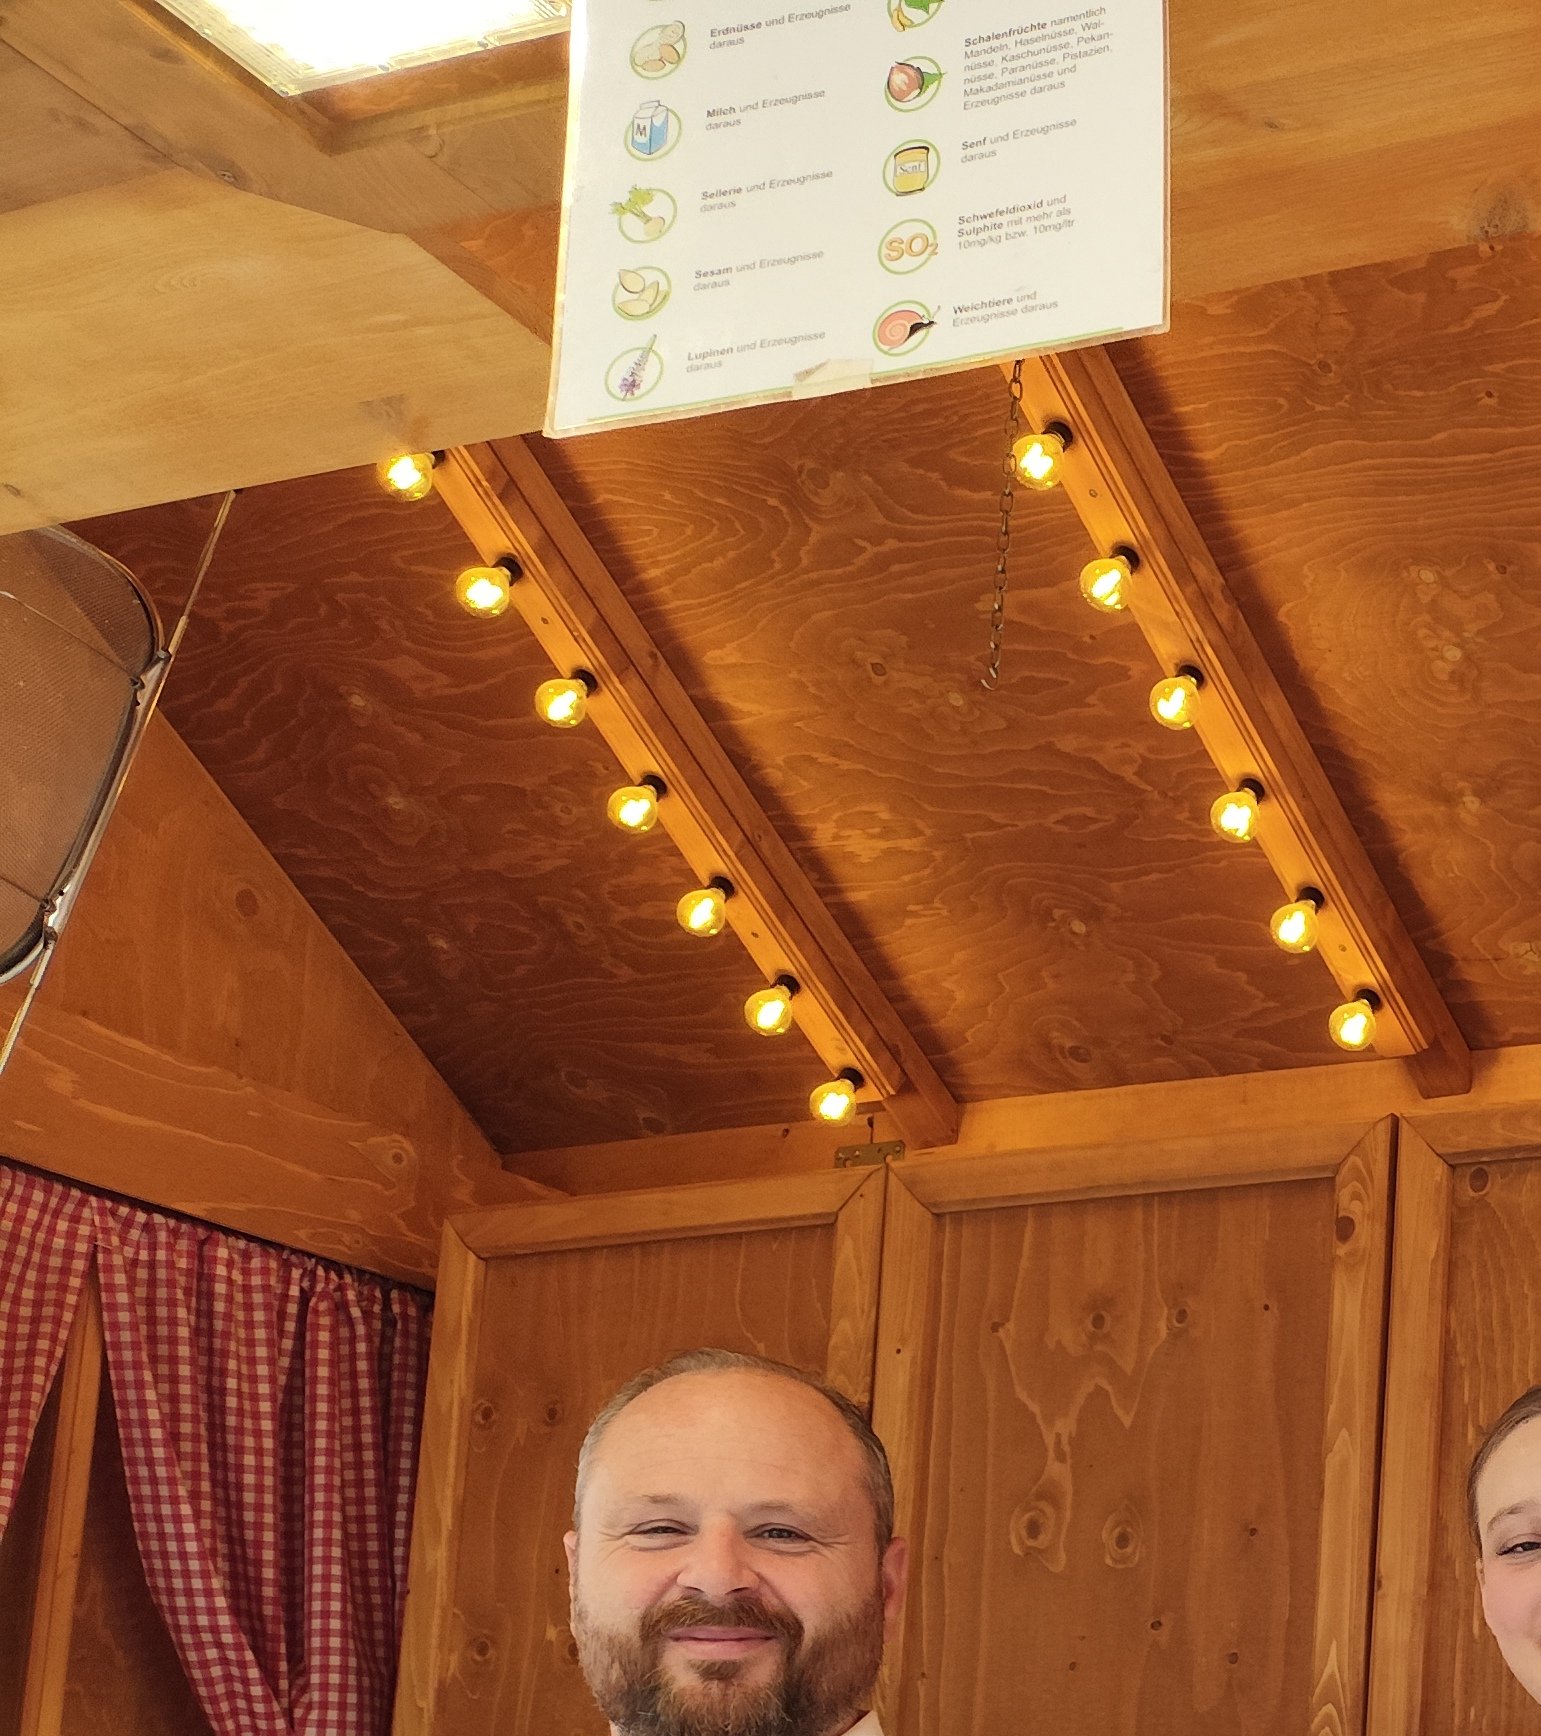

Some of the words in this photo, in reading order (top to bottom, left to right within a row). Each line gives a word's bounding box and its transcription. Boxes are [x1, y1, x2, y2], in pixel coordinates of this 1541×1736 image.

[710, 20, 762, 37] Erdnüsse
[765, 15, 785, 26] und
[788, 3, 851, 23] Erzeugnisse
[964, 20, 1047, 47] Schalenfrüchte
[1050, 5, 1106, 27] namentlich
[709, 36, 745, 49] daraus
[964, 43, 1010, 60] Mandeln,
[1015, 27, 1077, 48] Haselnüsse,
[1081, 19, 1105, 32] Wal-
[1001, 41, 1073, 63] Kaschunüsse,
[1077, 32, 1114, 46] Pekan-
[963, 87, 1027, 111] Erzeugnisse
[1030, 80, 1066, 96] daraus
[964, 68, 1054, 98] Makadamianüsse
[1057, 64, 1078, 78] und
[706, 106, 737, 118] Milch
[739, 101, 759, 113] und
[762, 90, 826, 108] Erzeugnisse
[705, 118, 742, 132] daraus
[961, 136, 987, 151] Senf
[990, 131, 1010, 145] und
[1012, 118, 1077, 140] Erzeugnisse
[960, 149, 997, 164] daraus
[701, 186, 743, 200] Sellerie
[746, 181, 766, 193] und
[769, 170, 833, 190] Erzeugnisse
[700, 200, 736, 213] daraus
[958, 199, 1043, 225] Schwefeldioxid
[1046, 194, 1067, 208] und
[957, 221, 1004, 240] Sulphite
[1006, 218, 1023, 228] mit
[1025, 211, 1053, 223] mehr
[1056, 206, 1072, 217] als
[958, 232, 1002, 250] 10mg/kg
[695, 267, 732, 279] Sesam
[736, 260, 756, 272] und
[759, 250, 824, 269] Erzeugnisse
[693, 278, 730, 292] daraus
[952, 296, 1014, 315] Weichtiere
[1016, 291, 1037, 303] und
[952, 309, 1019, 328] Erzeugnisse
[1021, 300, 1059, 316] daraus
[687, 346, 734, 361] Lupinen
[737, 341, 757, 353] und
[760, 331, 826, 349] Erzeugnisse
[686, 360, 723, 373] daraus
